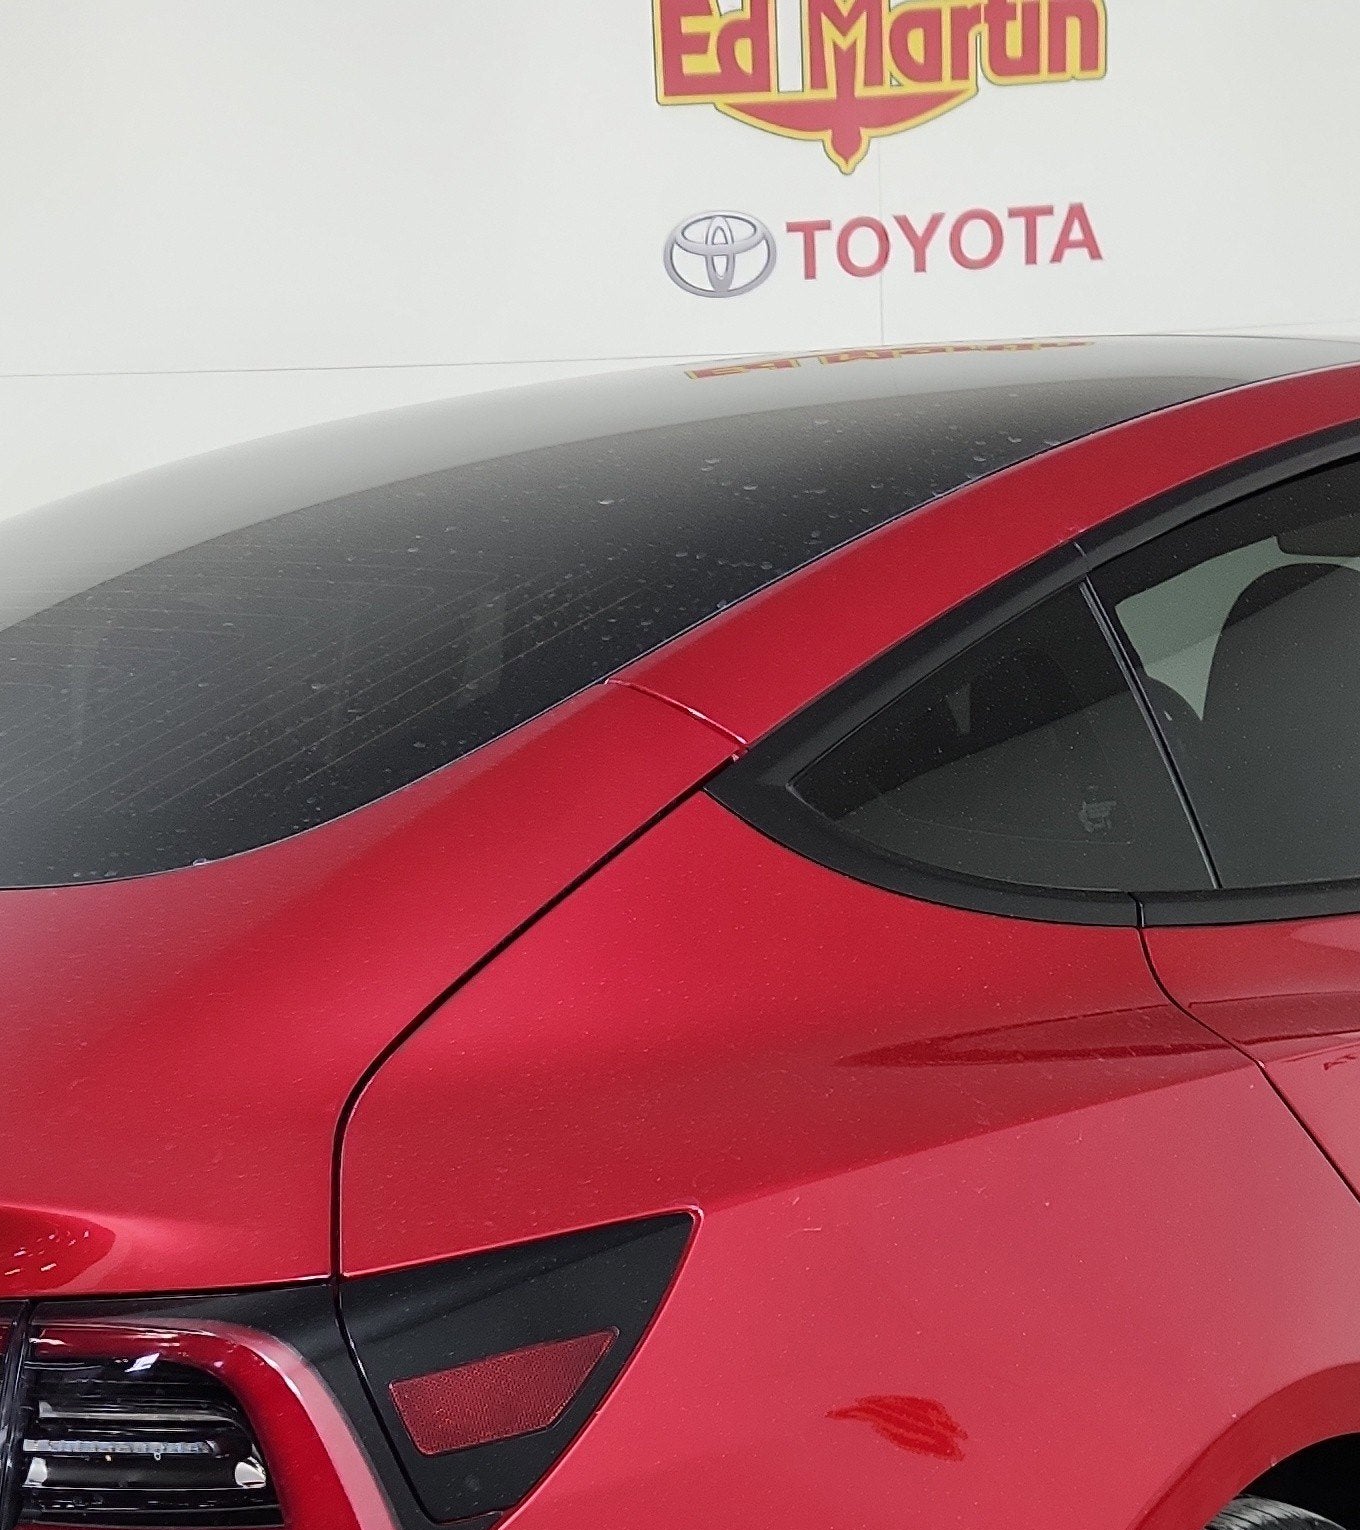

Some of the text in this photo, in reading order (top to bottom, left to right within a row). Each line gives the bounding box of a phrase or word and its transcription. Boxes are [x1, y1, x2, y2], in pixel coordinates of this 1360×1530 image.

[655, 0, 1106, 101] Ed Martin
[785, 202, 1104, 281] TOYOTA
